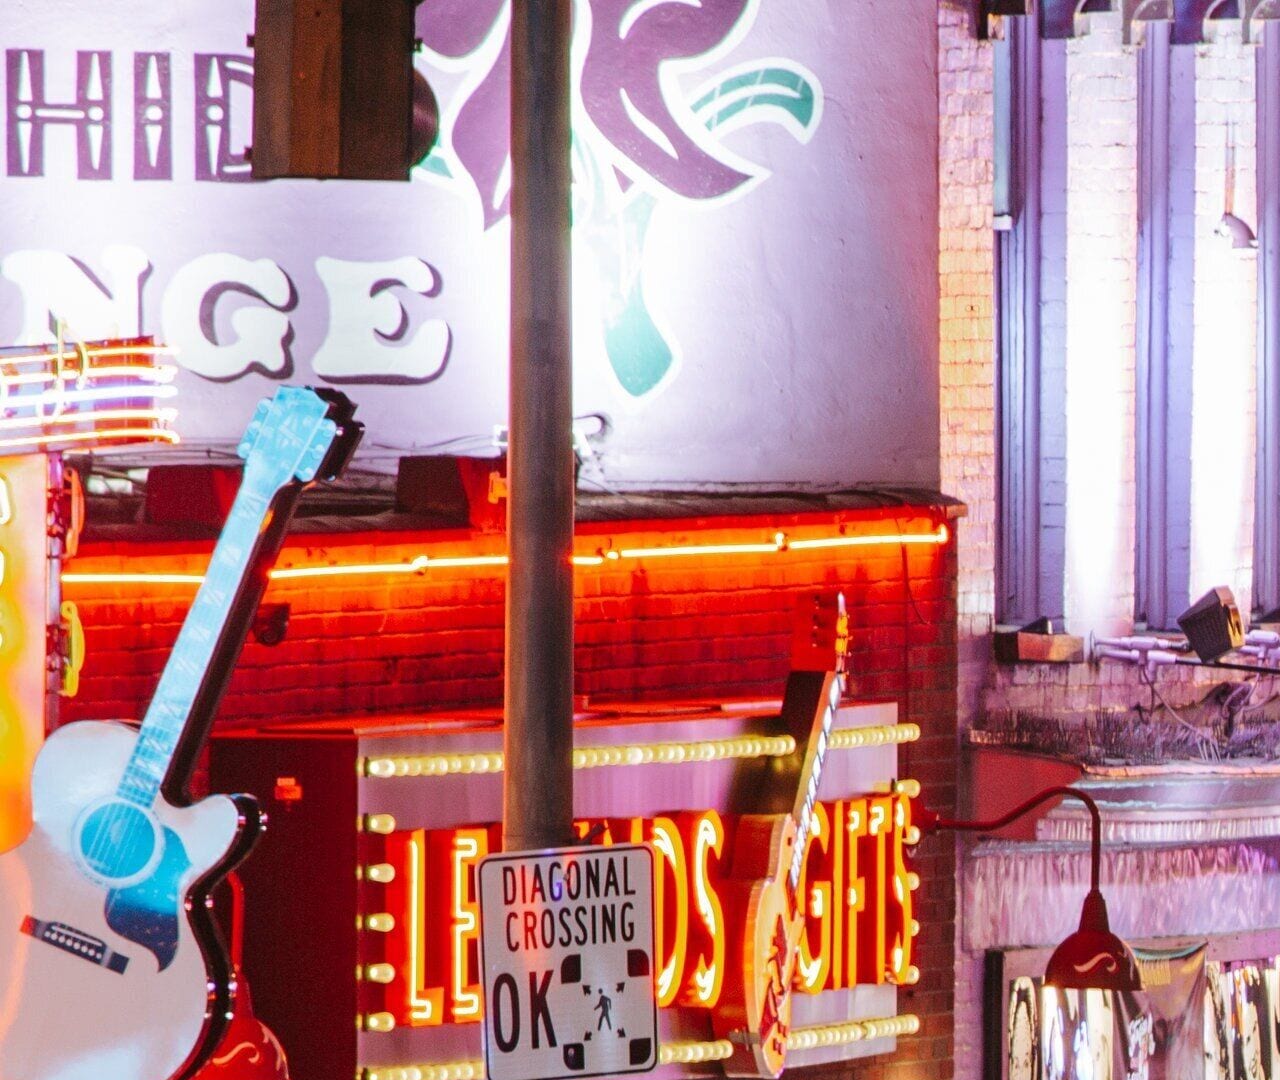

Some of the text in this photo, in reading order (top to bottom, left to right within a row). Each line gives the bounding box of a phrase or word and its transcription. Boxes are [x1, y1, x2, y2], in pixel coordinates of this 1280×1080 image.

[409, 793, 914, 1026] LEDS GIFTS
[502, 857, 637, 906] DIAGONAL
[506, 902, 636, 953] CROSSING
[492, 969, 558, 1053] OK
